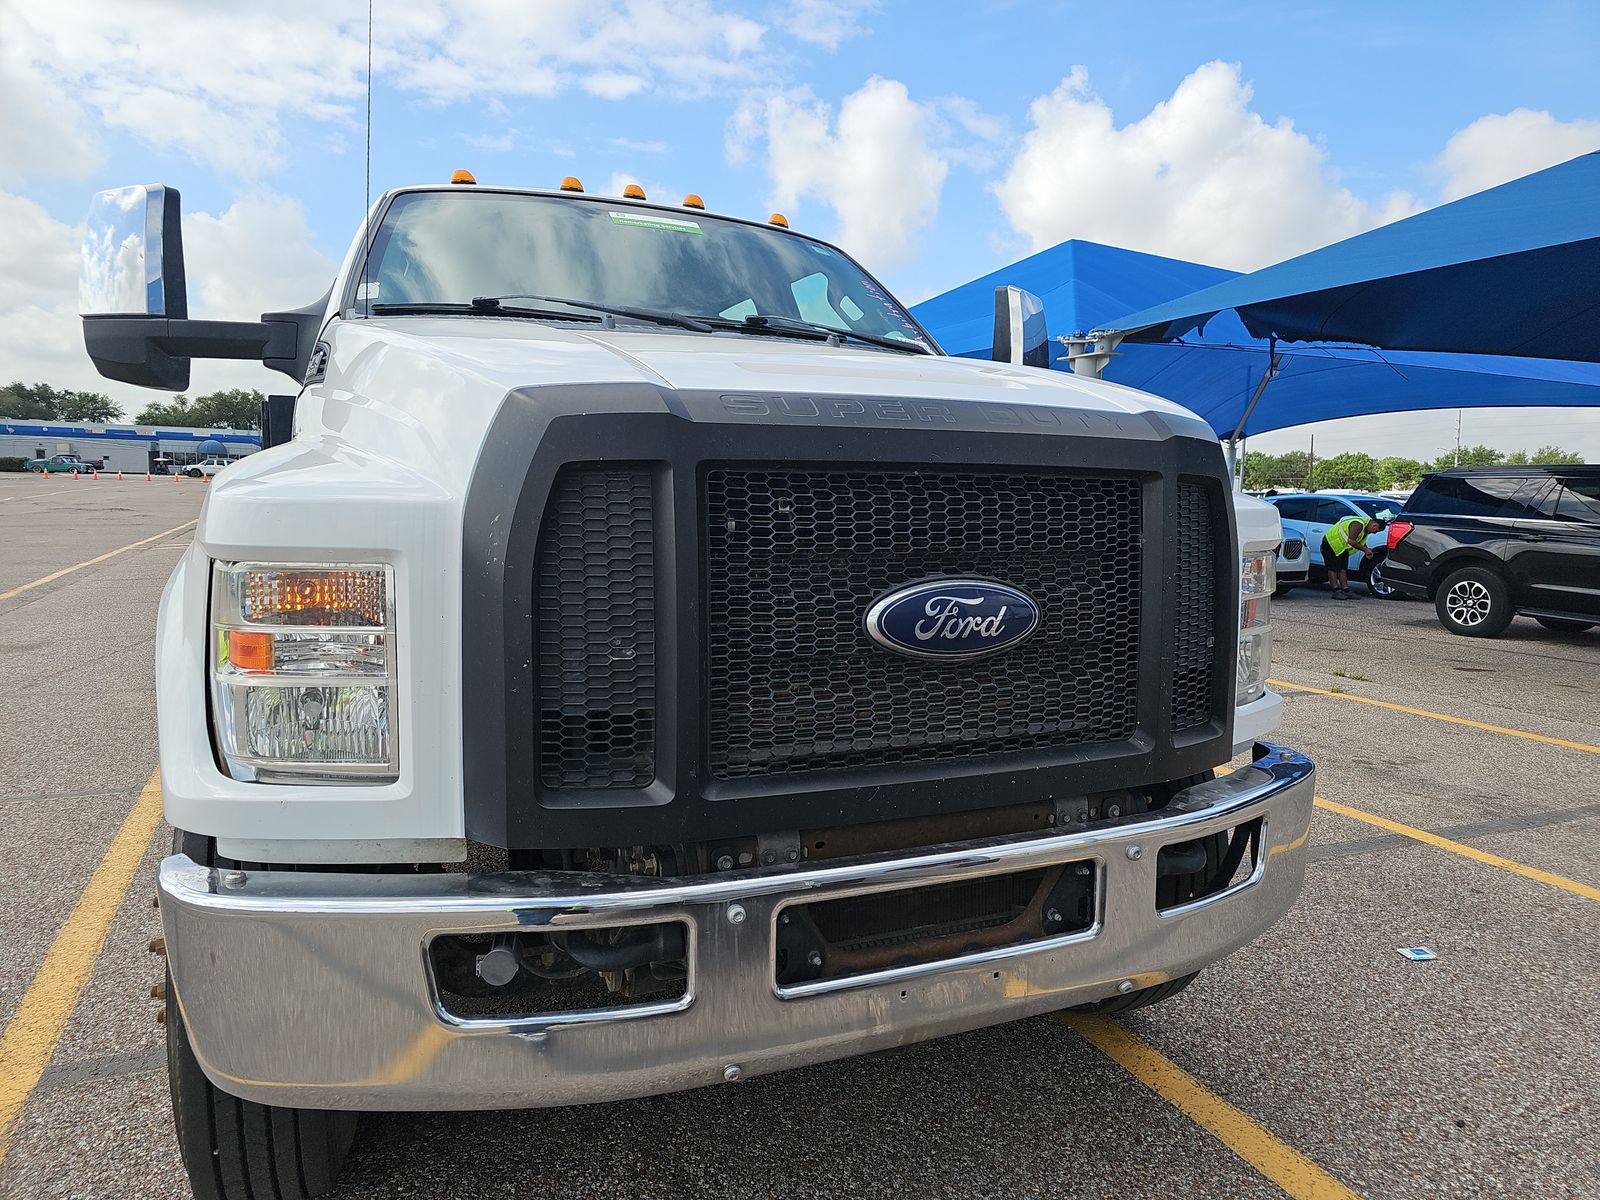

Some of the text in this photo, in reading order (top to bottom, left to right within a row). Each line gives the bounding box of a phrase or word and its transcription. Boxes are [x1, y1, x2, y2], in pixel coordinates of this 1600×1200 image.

[719, 394, 1126, 433] SUPER DUTY
[914, 596, 1007, 641] Ford
